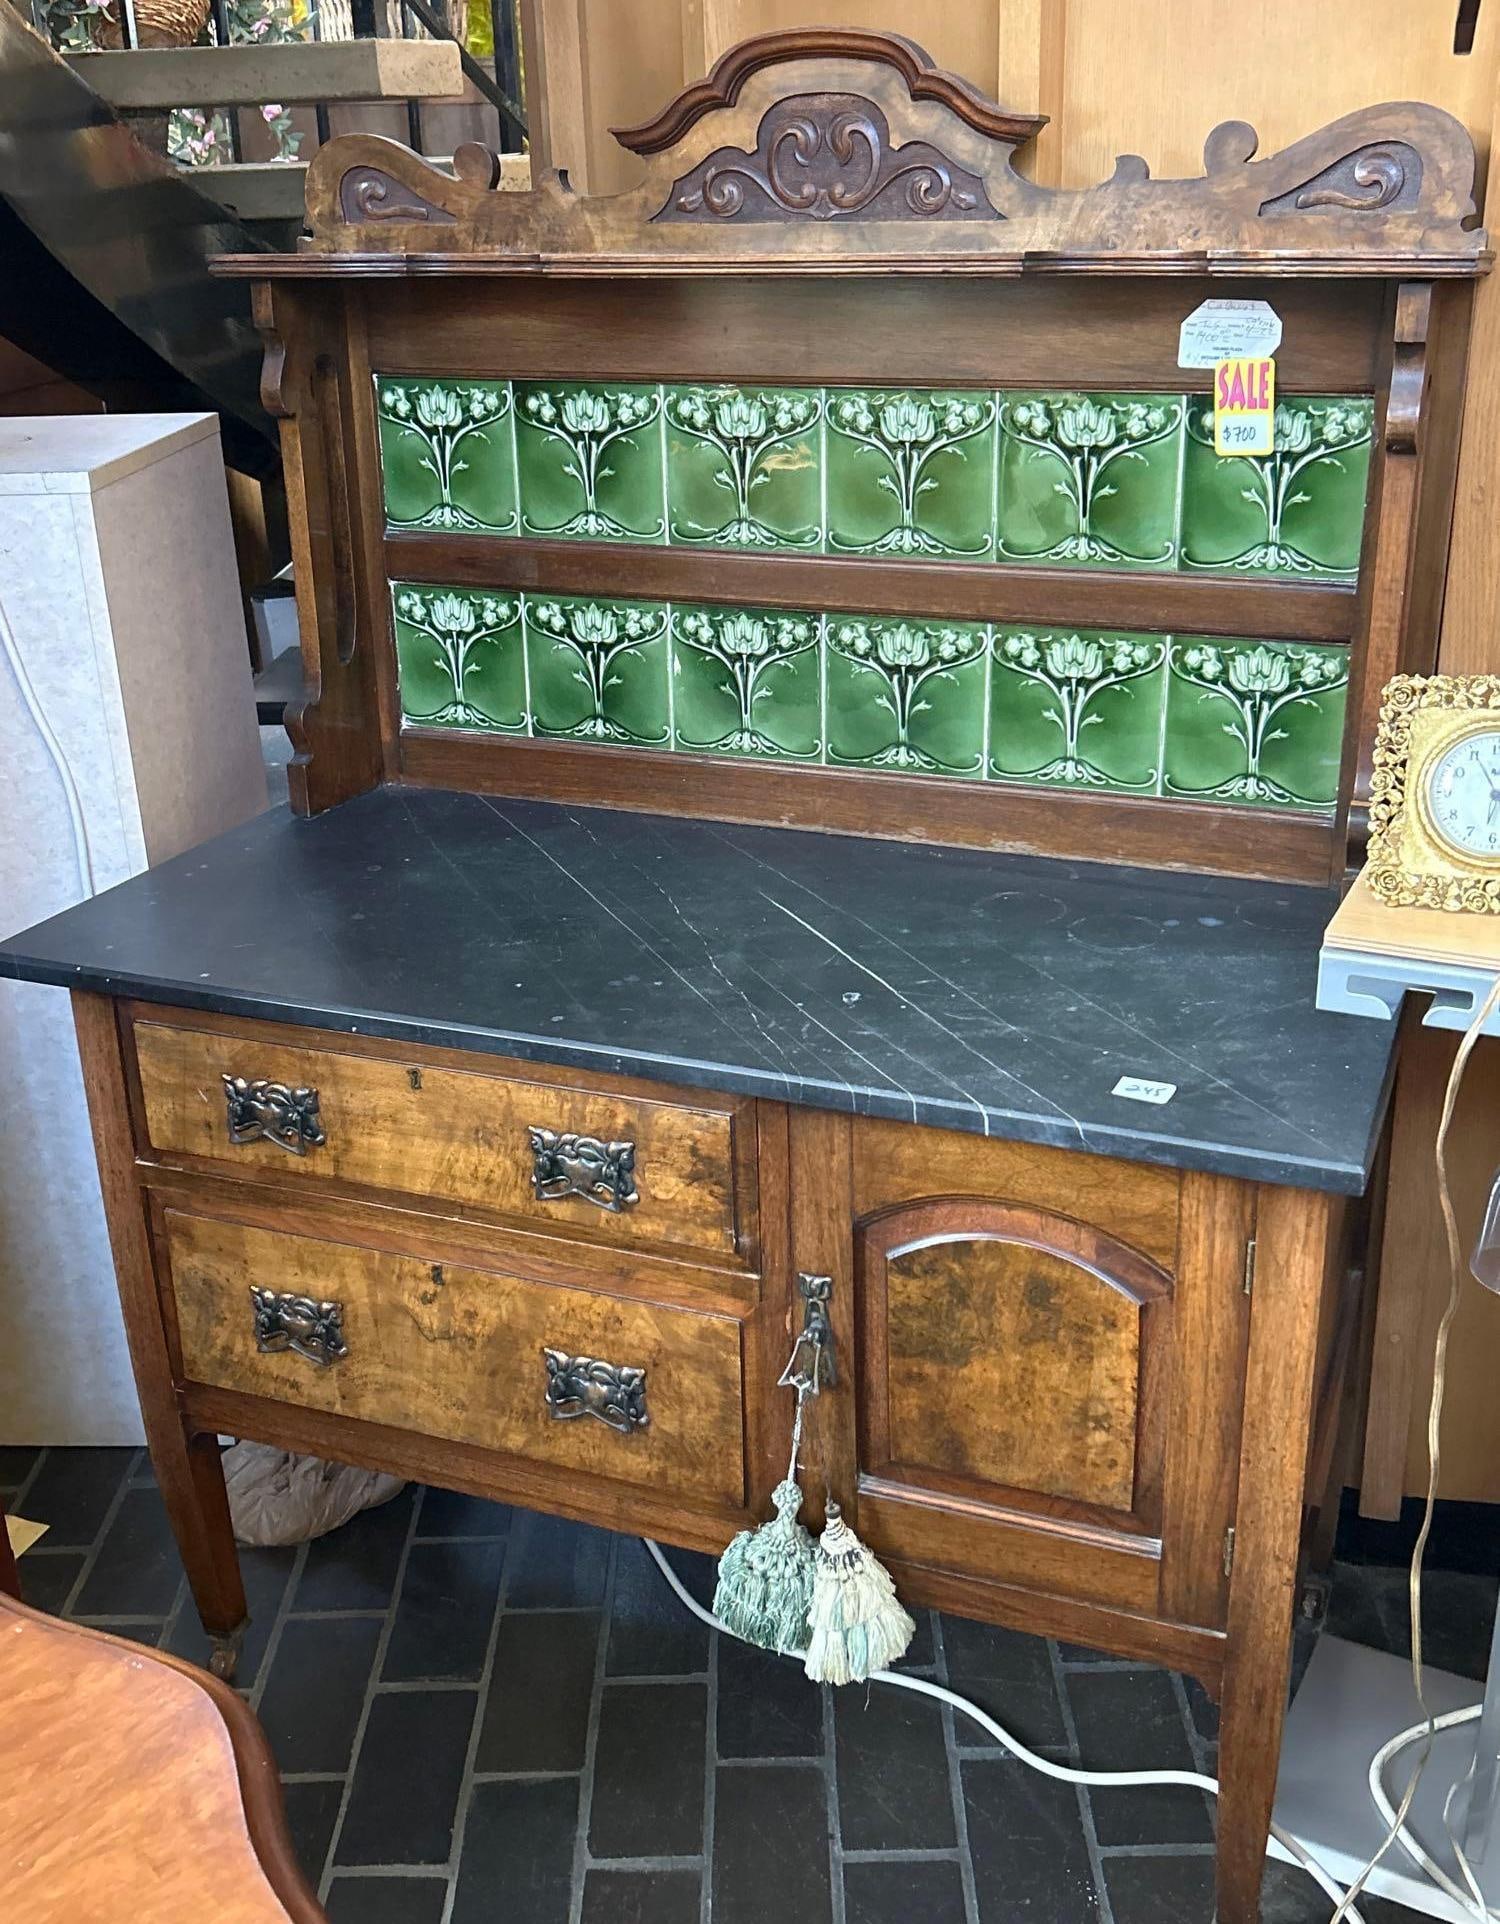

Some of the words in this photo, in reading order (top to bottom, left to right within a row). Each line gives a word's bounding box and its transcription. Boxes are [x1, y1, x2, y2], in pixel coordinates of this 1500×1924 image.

[1218, 362, 1270, 411] SALE
[1223, 425, 1256, 442] $700
[1449, 808, 1458, 820] 8
[1466, 826, 1475, 837] 7
[1488, 832, 1497, 844] 6
